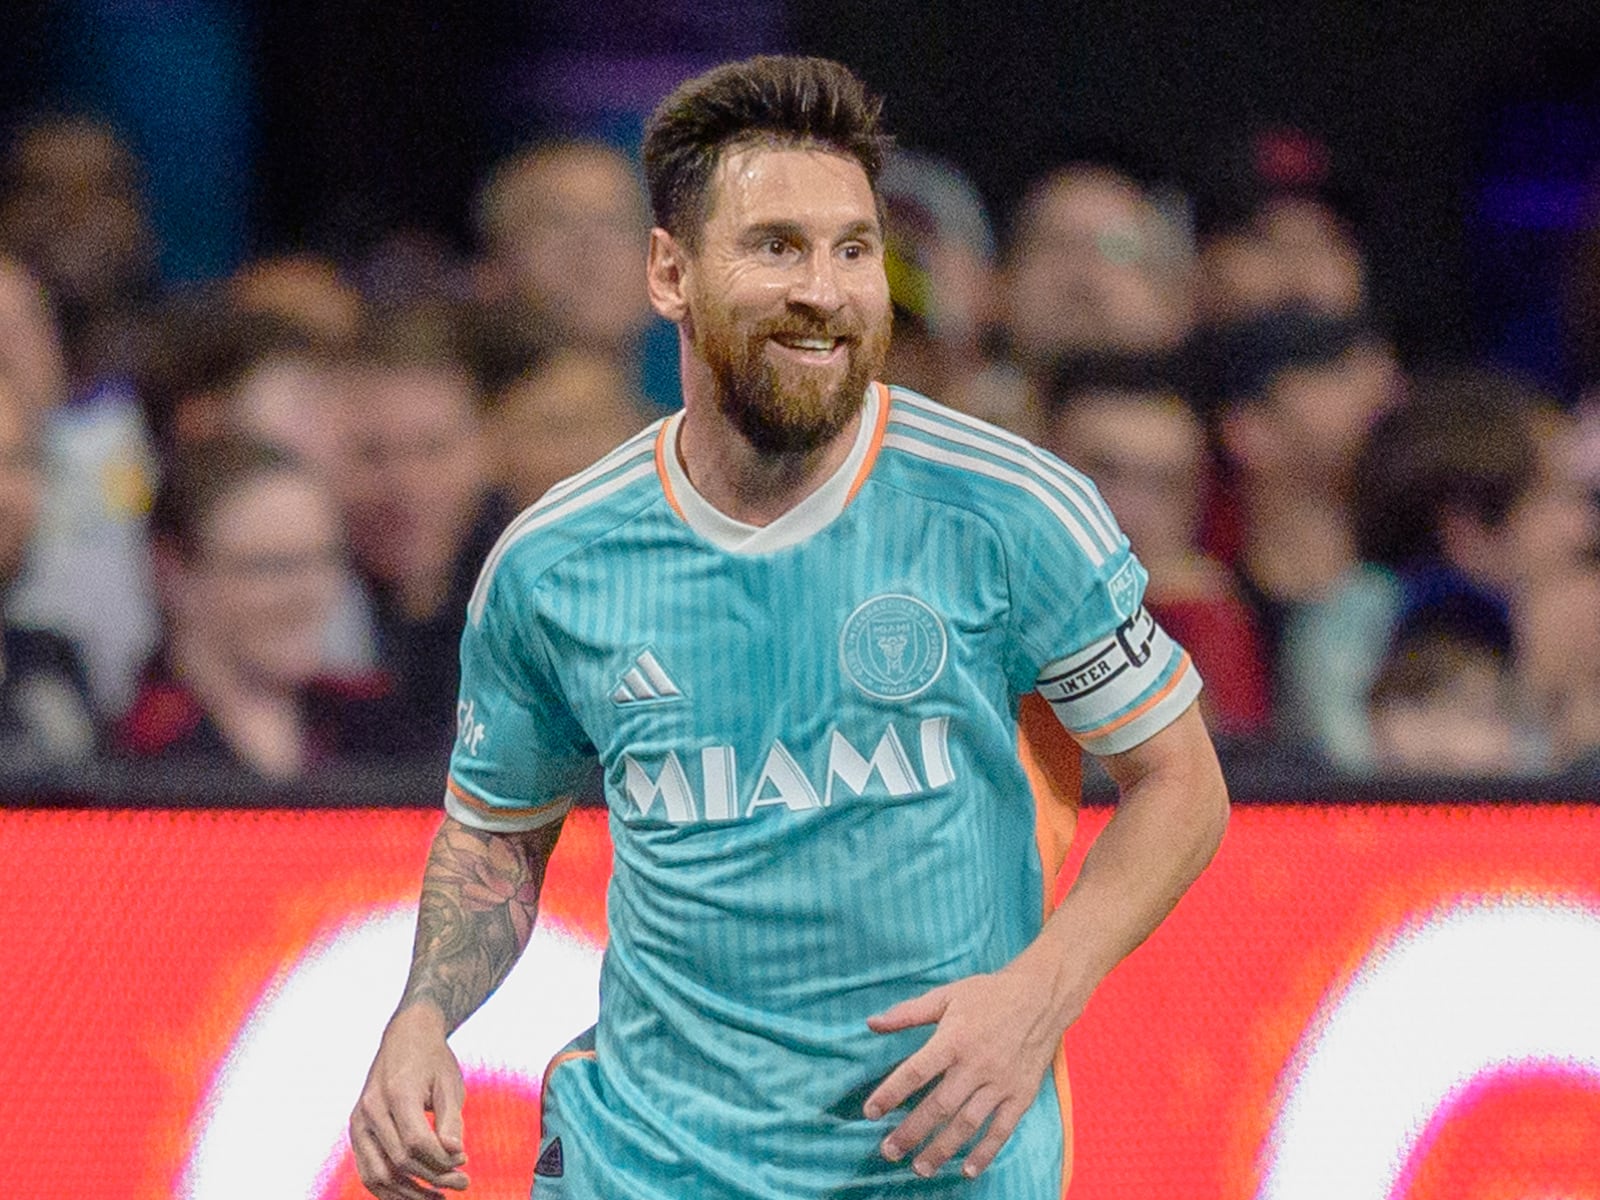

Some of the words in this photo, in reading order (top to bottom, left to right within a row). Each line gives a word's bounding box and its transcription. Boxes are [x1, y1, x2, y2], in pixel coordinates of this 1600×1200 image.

[1116, 615, 1151, 668] C
[1060, 660, 1111, 694] INTER
[622, 716, 956, 823] MIAMI
